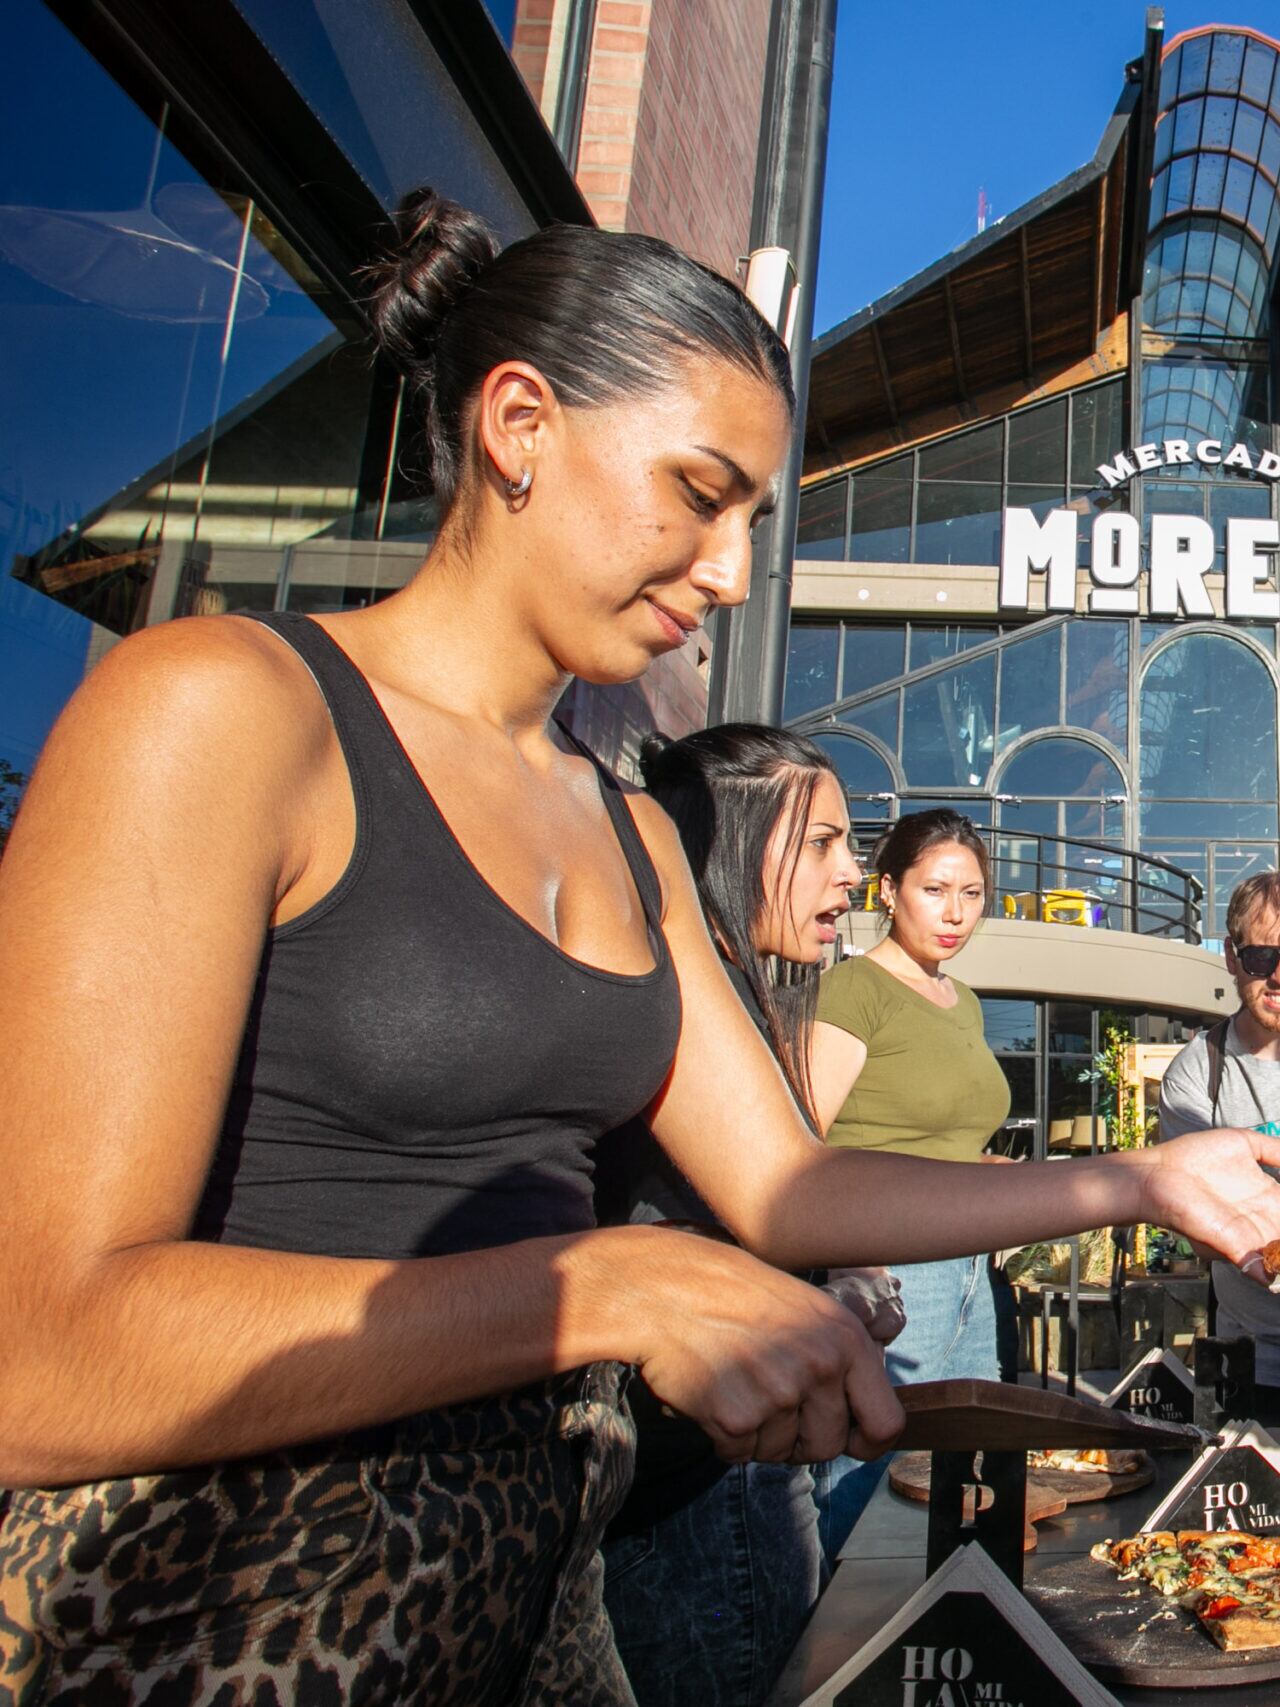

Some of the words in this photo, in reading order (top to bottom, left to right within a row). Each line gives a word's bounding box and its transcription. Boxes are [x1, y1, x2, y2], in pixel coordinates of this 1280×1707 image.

[1129, 1387, 1161, 1407] HO
[1204, 1481, 1250, 1510] HO
[1204, 1508, 1241, 1532] LA
[1249, 1503, 1267, 1517] MI
[900, 1646, 974, 1681] HO
[974, 1682, 1003, 1700] MI
